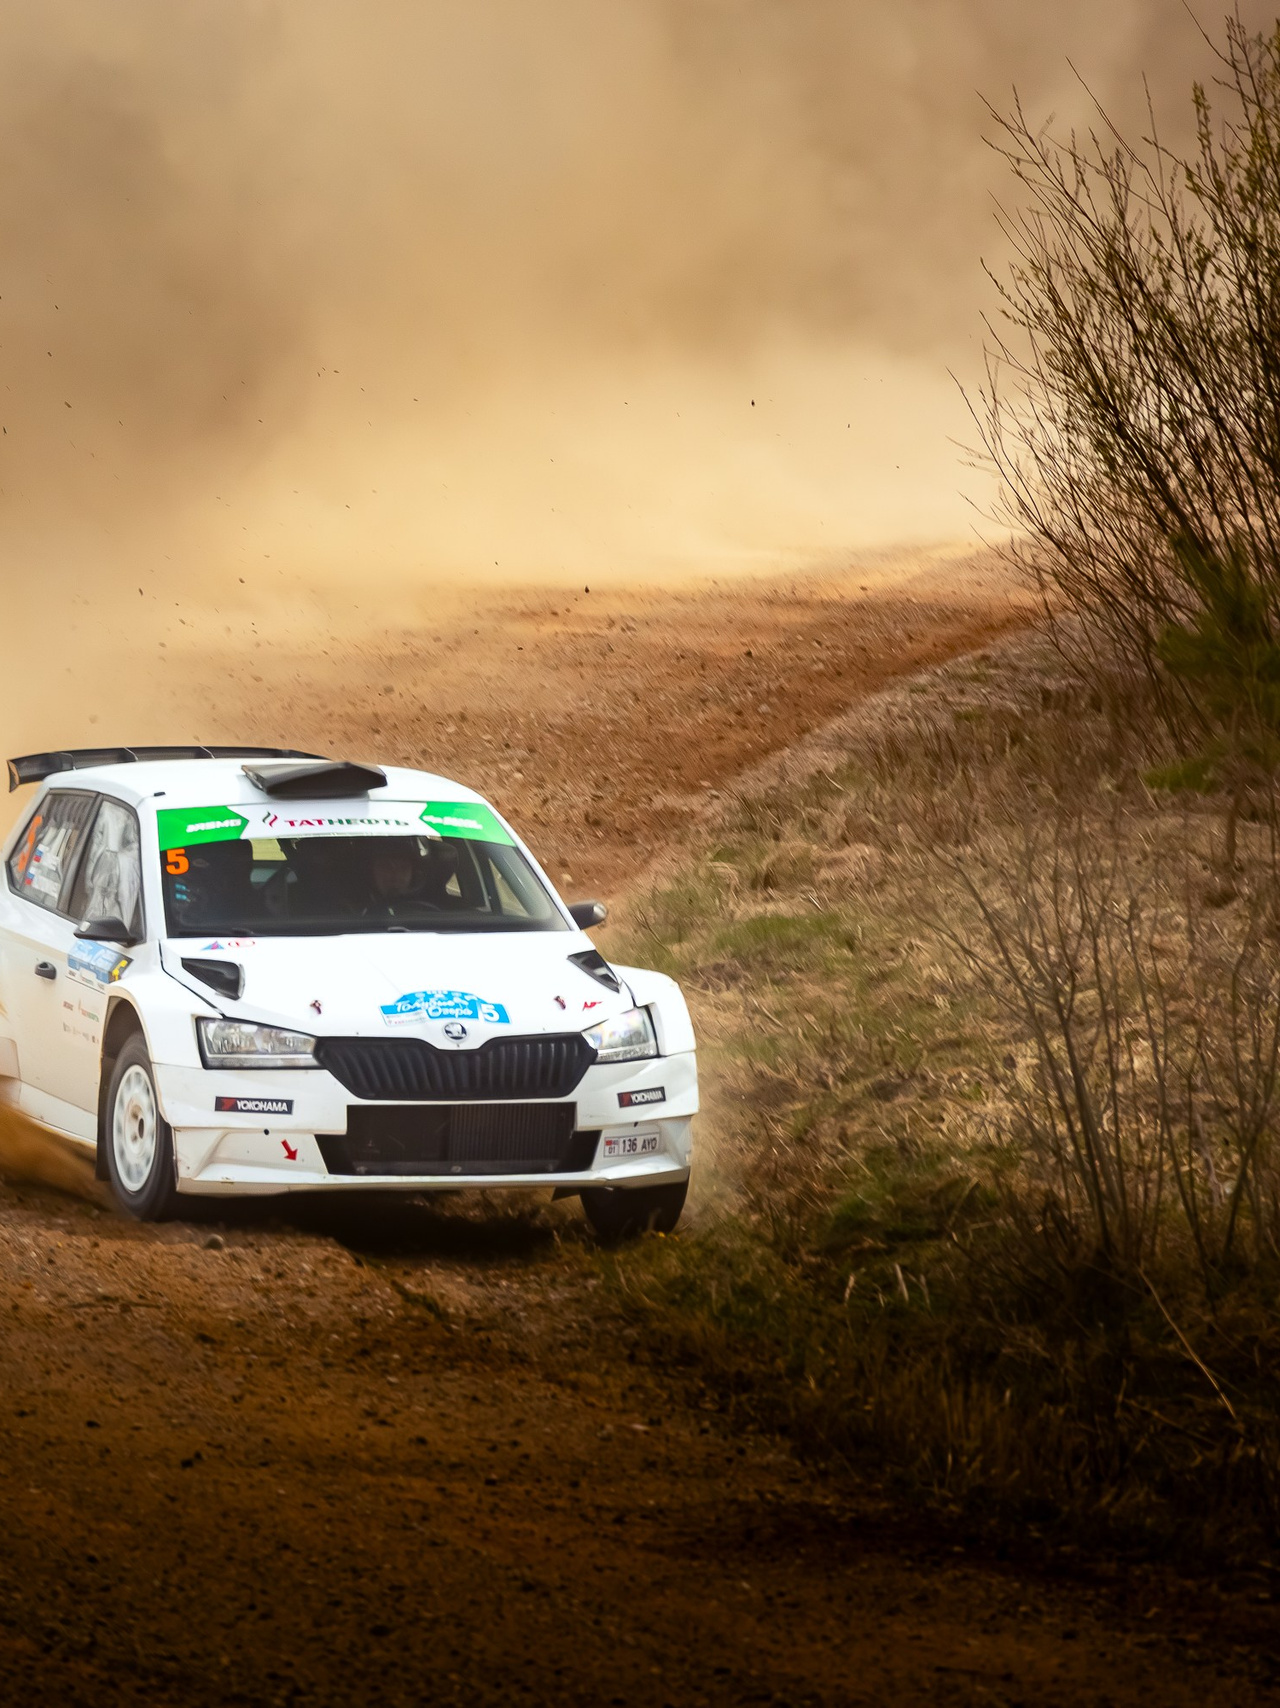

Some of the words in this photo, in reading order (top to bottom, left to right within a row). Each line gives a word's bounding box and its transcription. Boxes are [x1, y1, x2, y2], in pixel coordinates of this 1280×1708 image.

[283, 818, 410, 828] ТАТНЕФТЬ
[166, 848, 190, 875] 5
[481, 1003, 500, 1022] 5
[631, 1090, 663, 1104] YOKOHAMA
[237, 1100, 288, 1112] YOKOHAMA
[622, 1138, 637, 1153] 136
